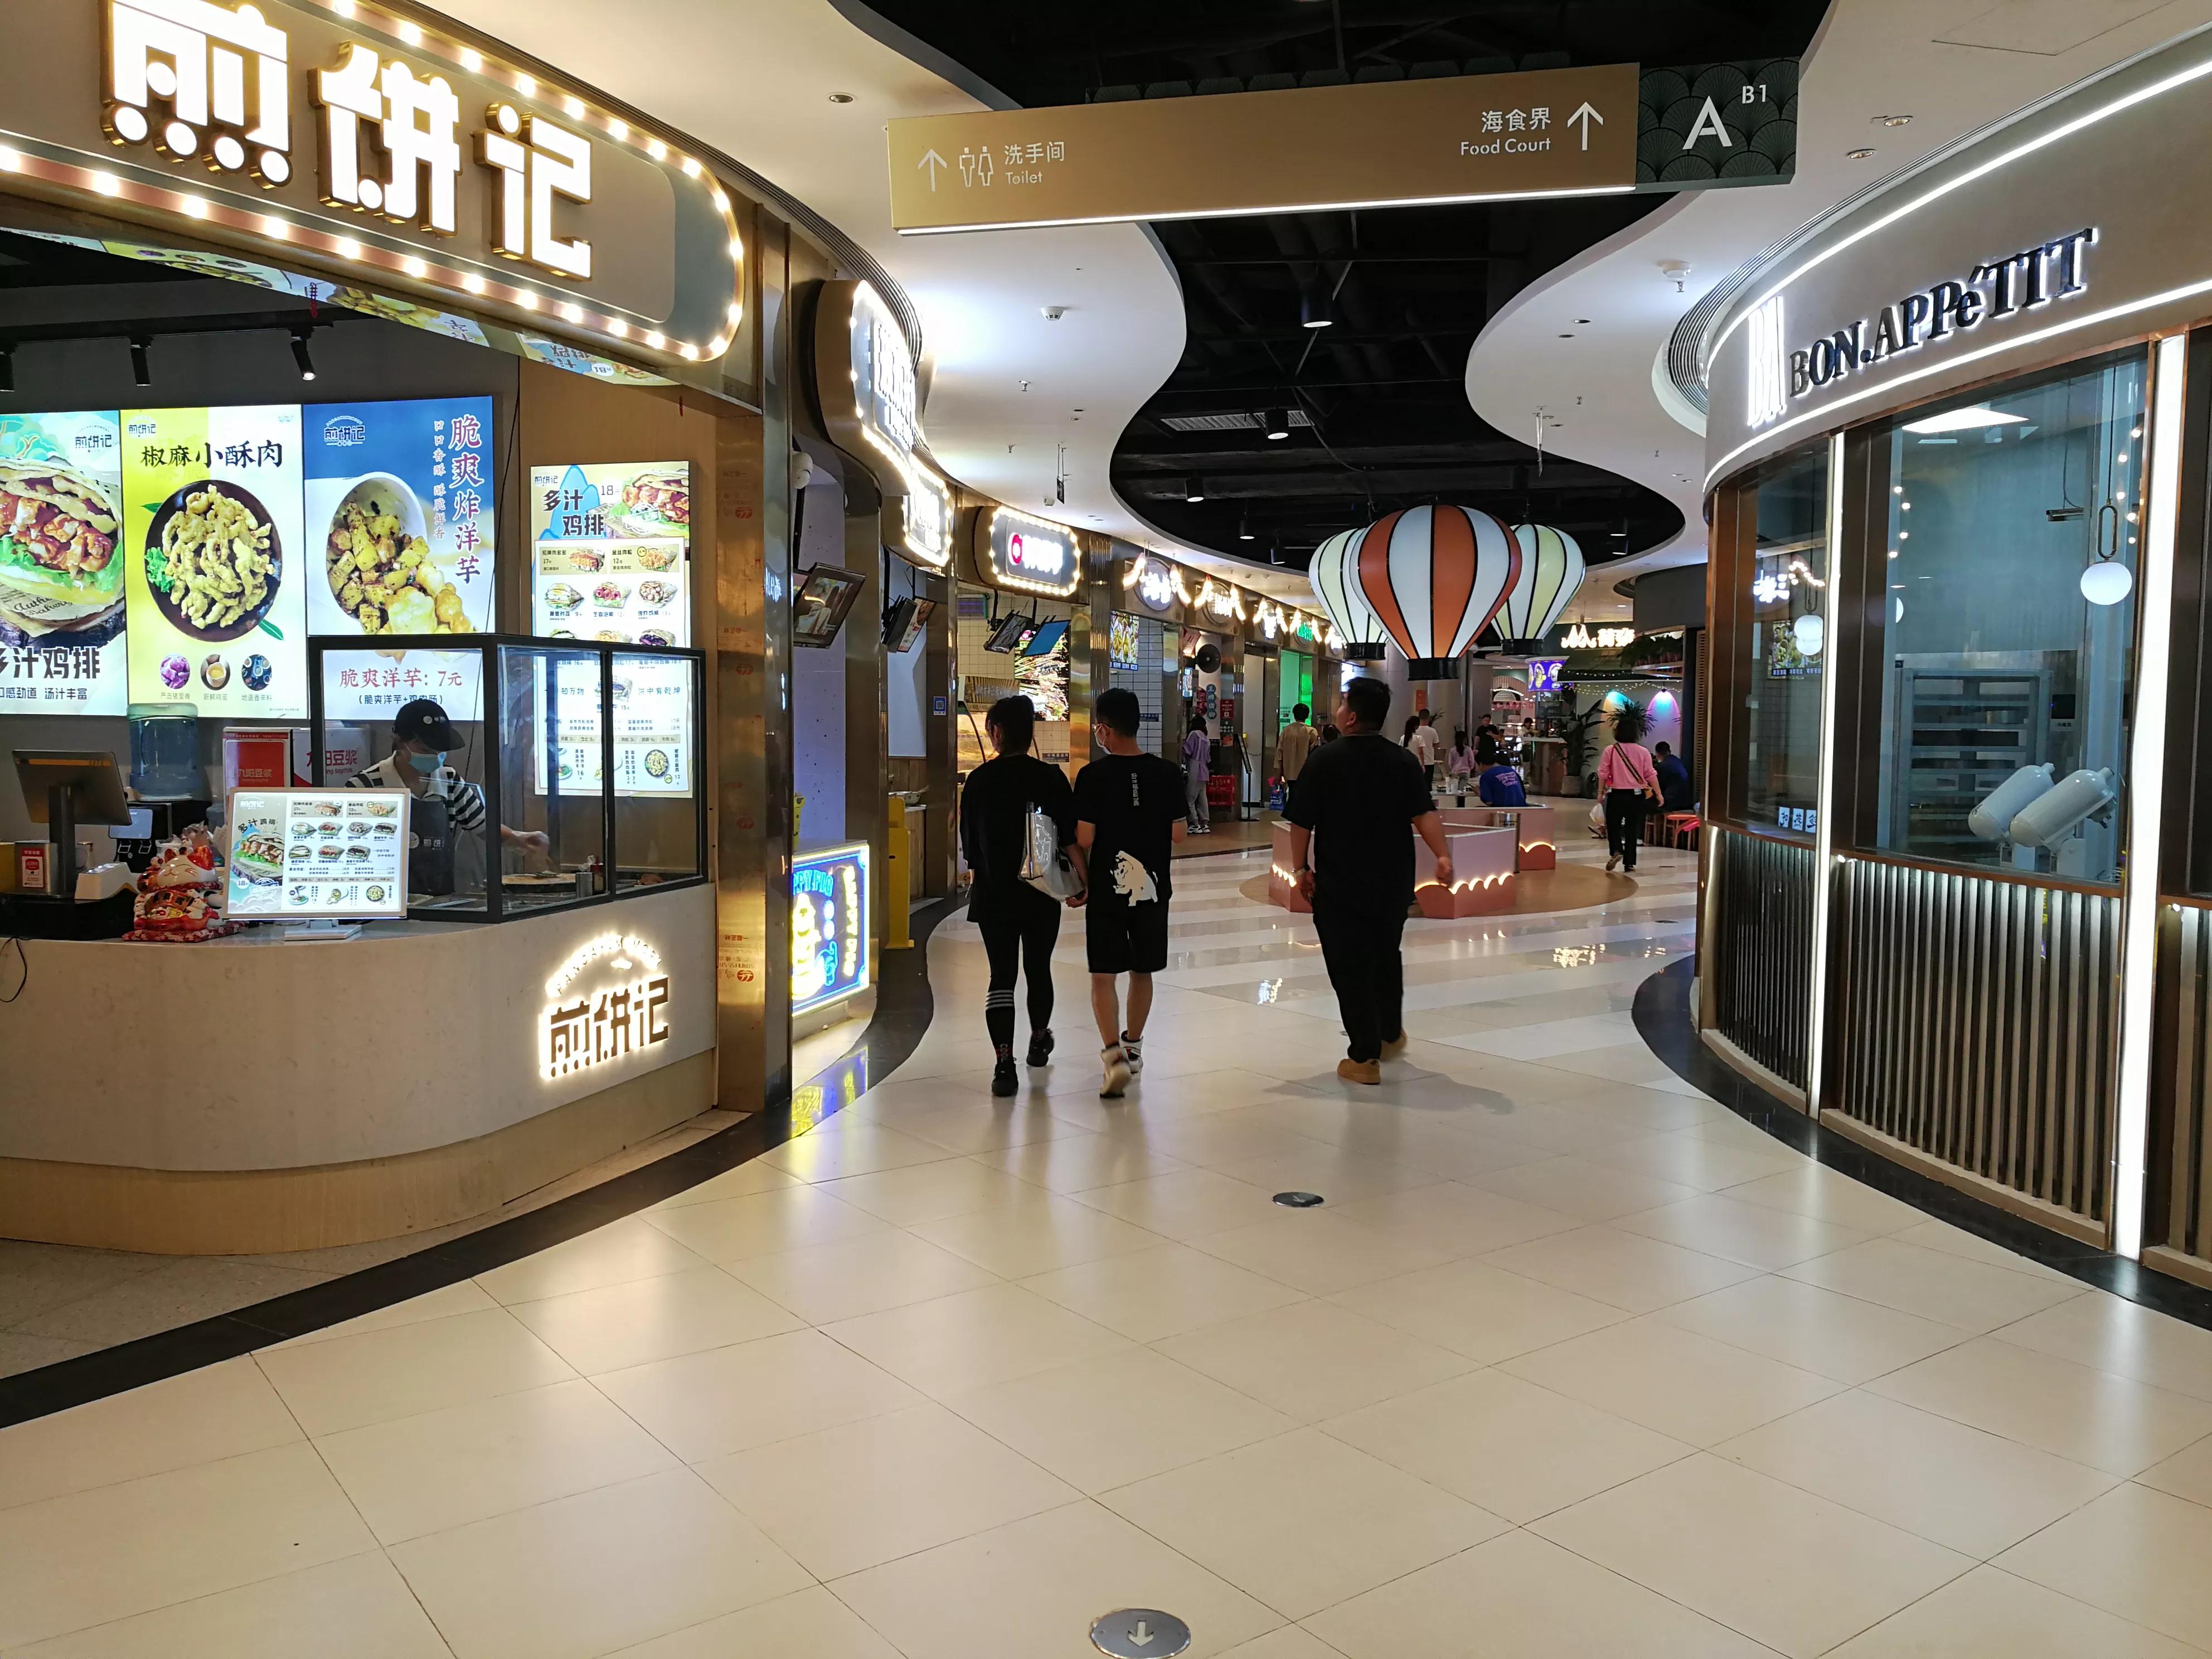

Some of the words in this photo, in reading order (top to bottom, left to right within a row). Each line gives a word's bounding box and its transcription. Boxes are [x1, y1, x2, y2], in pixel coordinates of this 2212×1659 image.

[1742, 84, 1767, 104] B1
[1481, 106, 1551, 133] 海食界
[1682, 95, 1733, 151] A
[100, 0, 593, 281] 煎饼记
[1461, 138, 1501, 156] Food
[1505, 137, 1551, 153] Court
[1004, 141, 1065, 166] 洗手间
[1005, 169, 1042, 185] Toilet
[75, 434, 112, 449] 煎饼记
[324, 425, 365, 442] 煎饼记
[139, 440, 284, 469] 椒麻小酥肉
[448, 414, 485, 585] 脆爽炸洋芋
[542, 488, 584, 511] 多汁
[562, 513, 605, 536] 鸡排
[44, 687, 88, 700] 汤汁丰富
[550, 974, 668, 1078] 煎饼记
